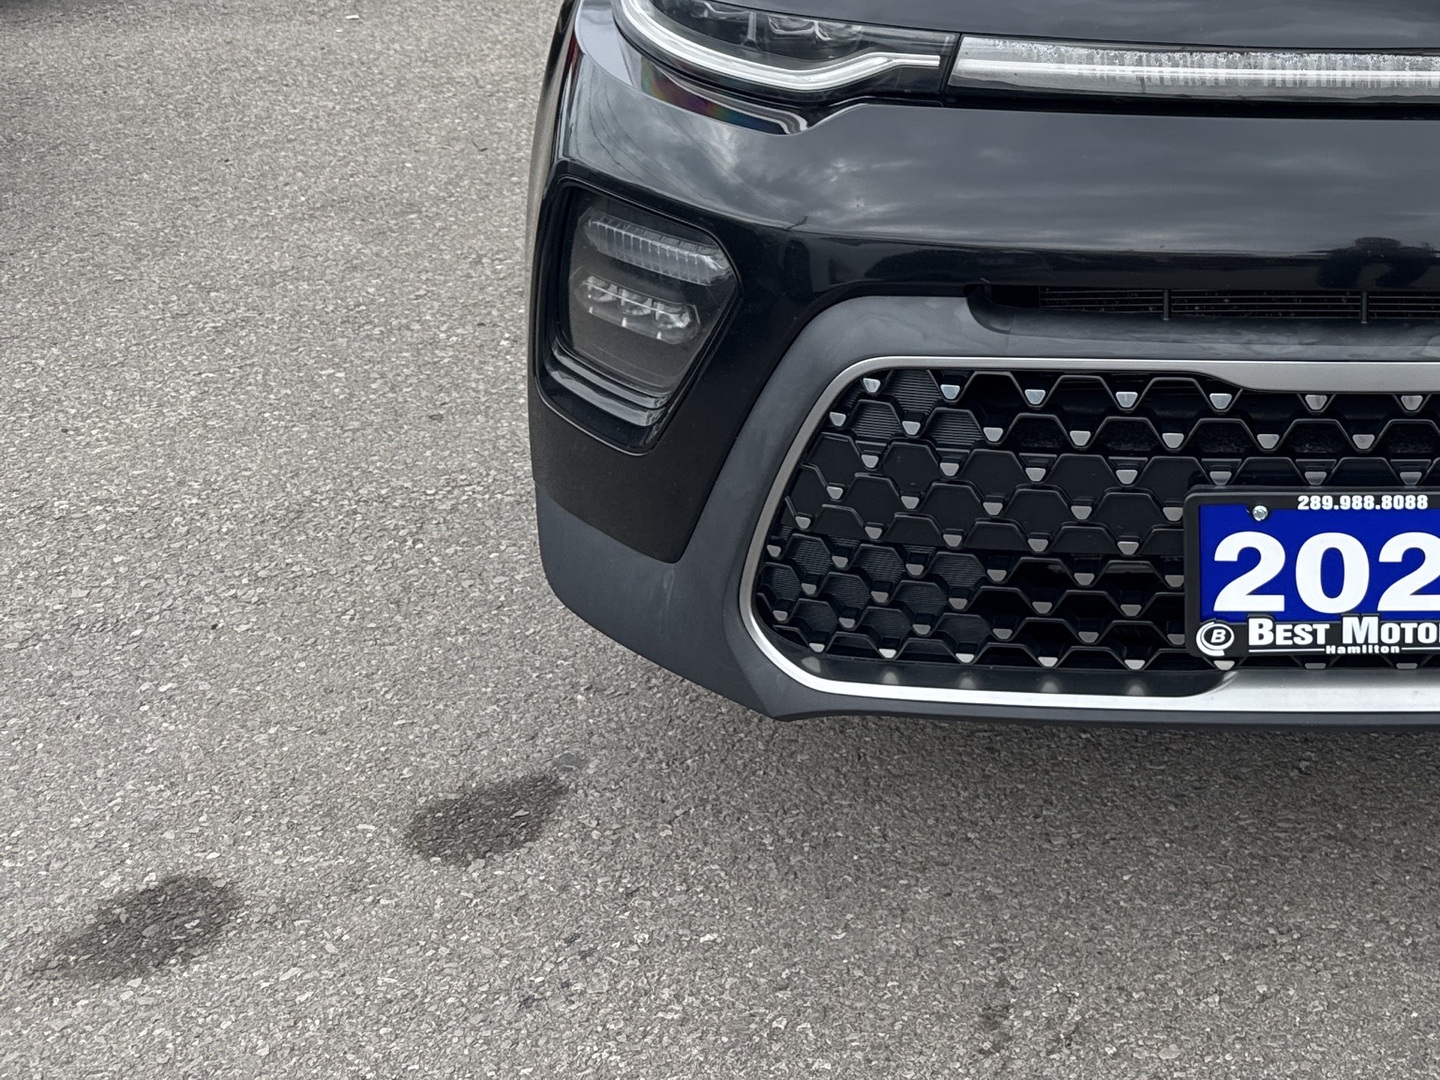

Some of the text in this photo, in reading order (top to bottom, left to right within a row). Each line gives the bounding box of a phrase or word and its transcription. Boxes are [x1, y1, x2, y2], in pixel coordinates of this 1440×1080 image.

[1297, 494, 1429, 511] 289.988.8088
[1248, 617, 1330, 646] BEST
[1325, 644, 1401, 655] Hamilton
